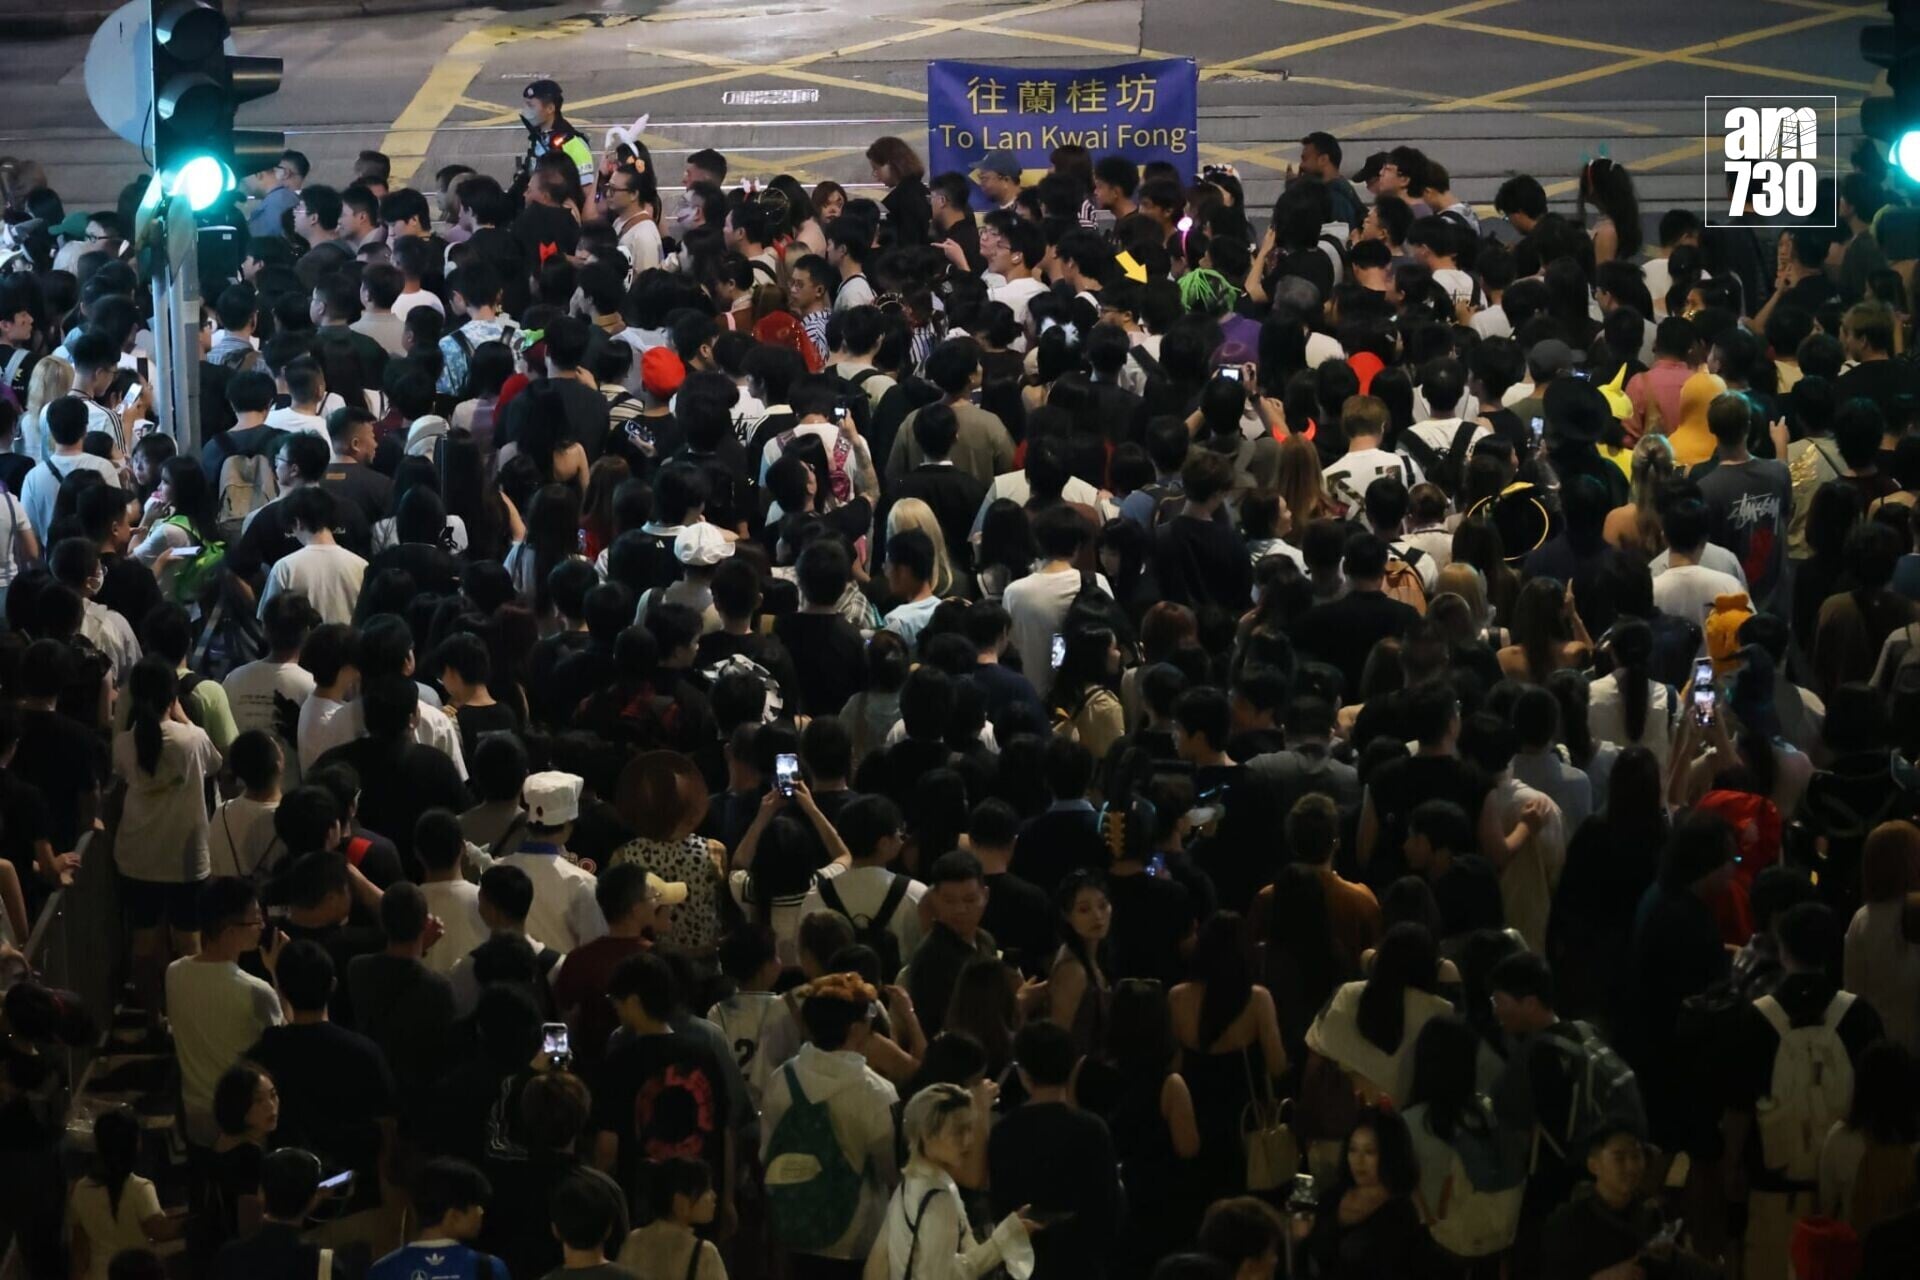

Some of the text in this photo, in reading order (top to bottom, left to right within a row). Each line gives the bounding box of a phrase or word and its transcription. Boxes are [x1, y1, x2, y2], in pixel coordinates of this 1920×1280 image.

[966, 73, 1158, 115] 往蘭桂坊
[939, 124, 1187, 153] To Lan Kwai Fong
